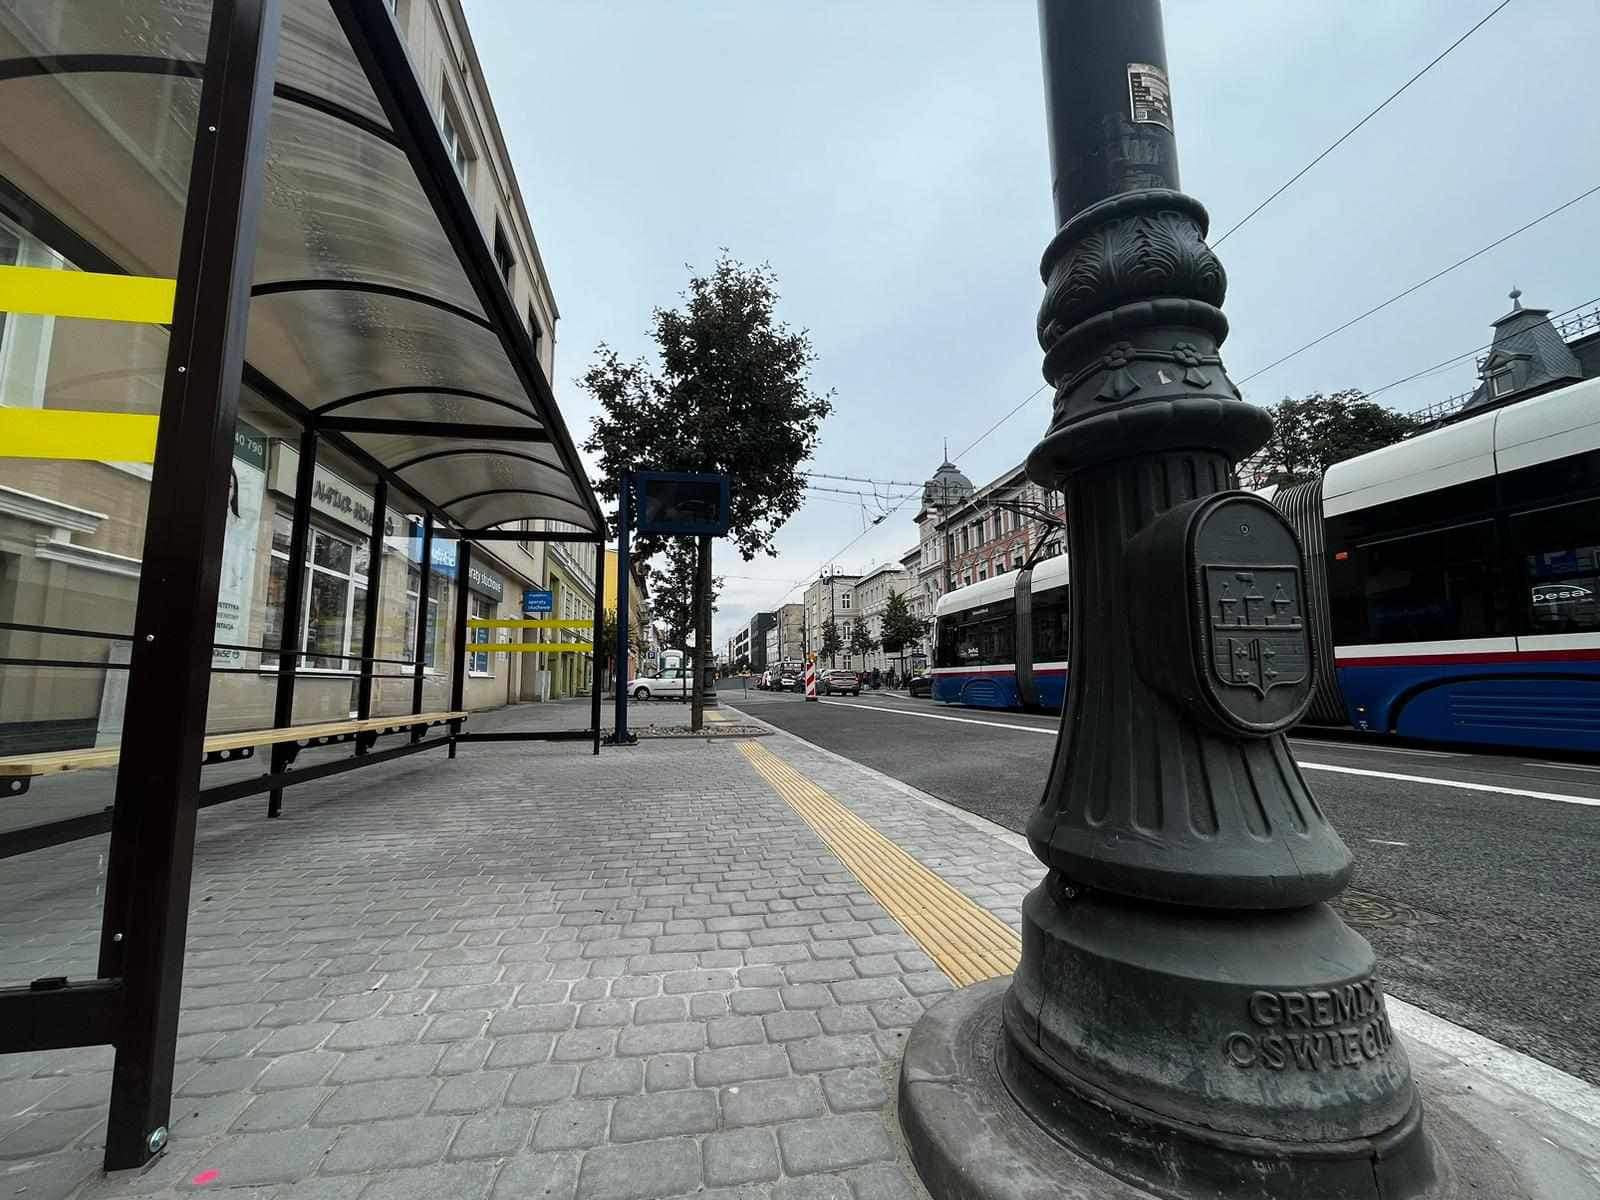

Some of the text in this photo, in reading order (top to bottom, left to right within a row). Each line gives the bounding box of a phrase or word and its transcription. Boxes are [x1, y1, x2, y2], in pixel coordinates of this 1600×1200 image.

[247, 438, 263, 457] 790
[468, 566, 481, 585] raty
[1532, 589, 1585, 603] pesa
